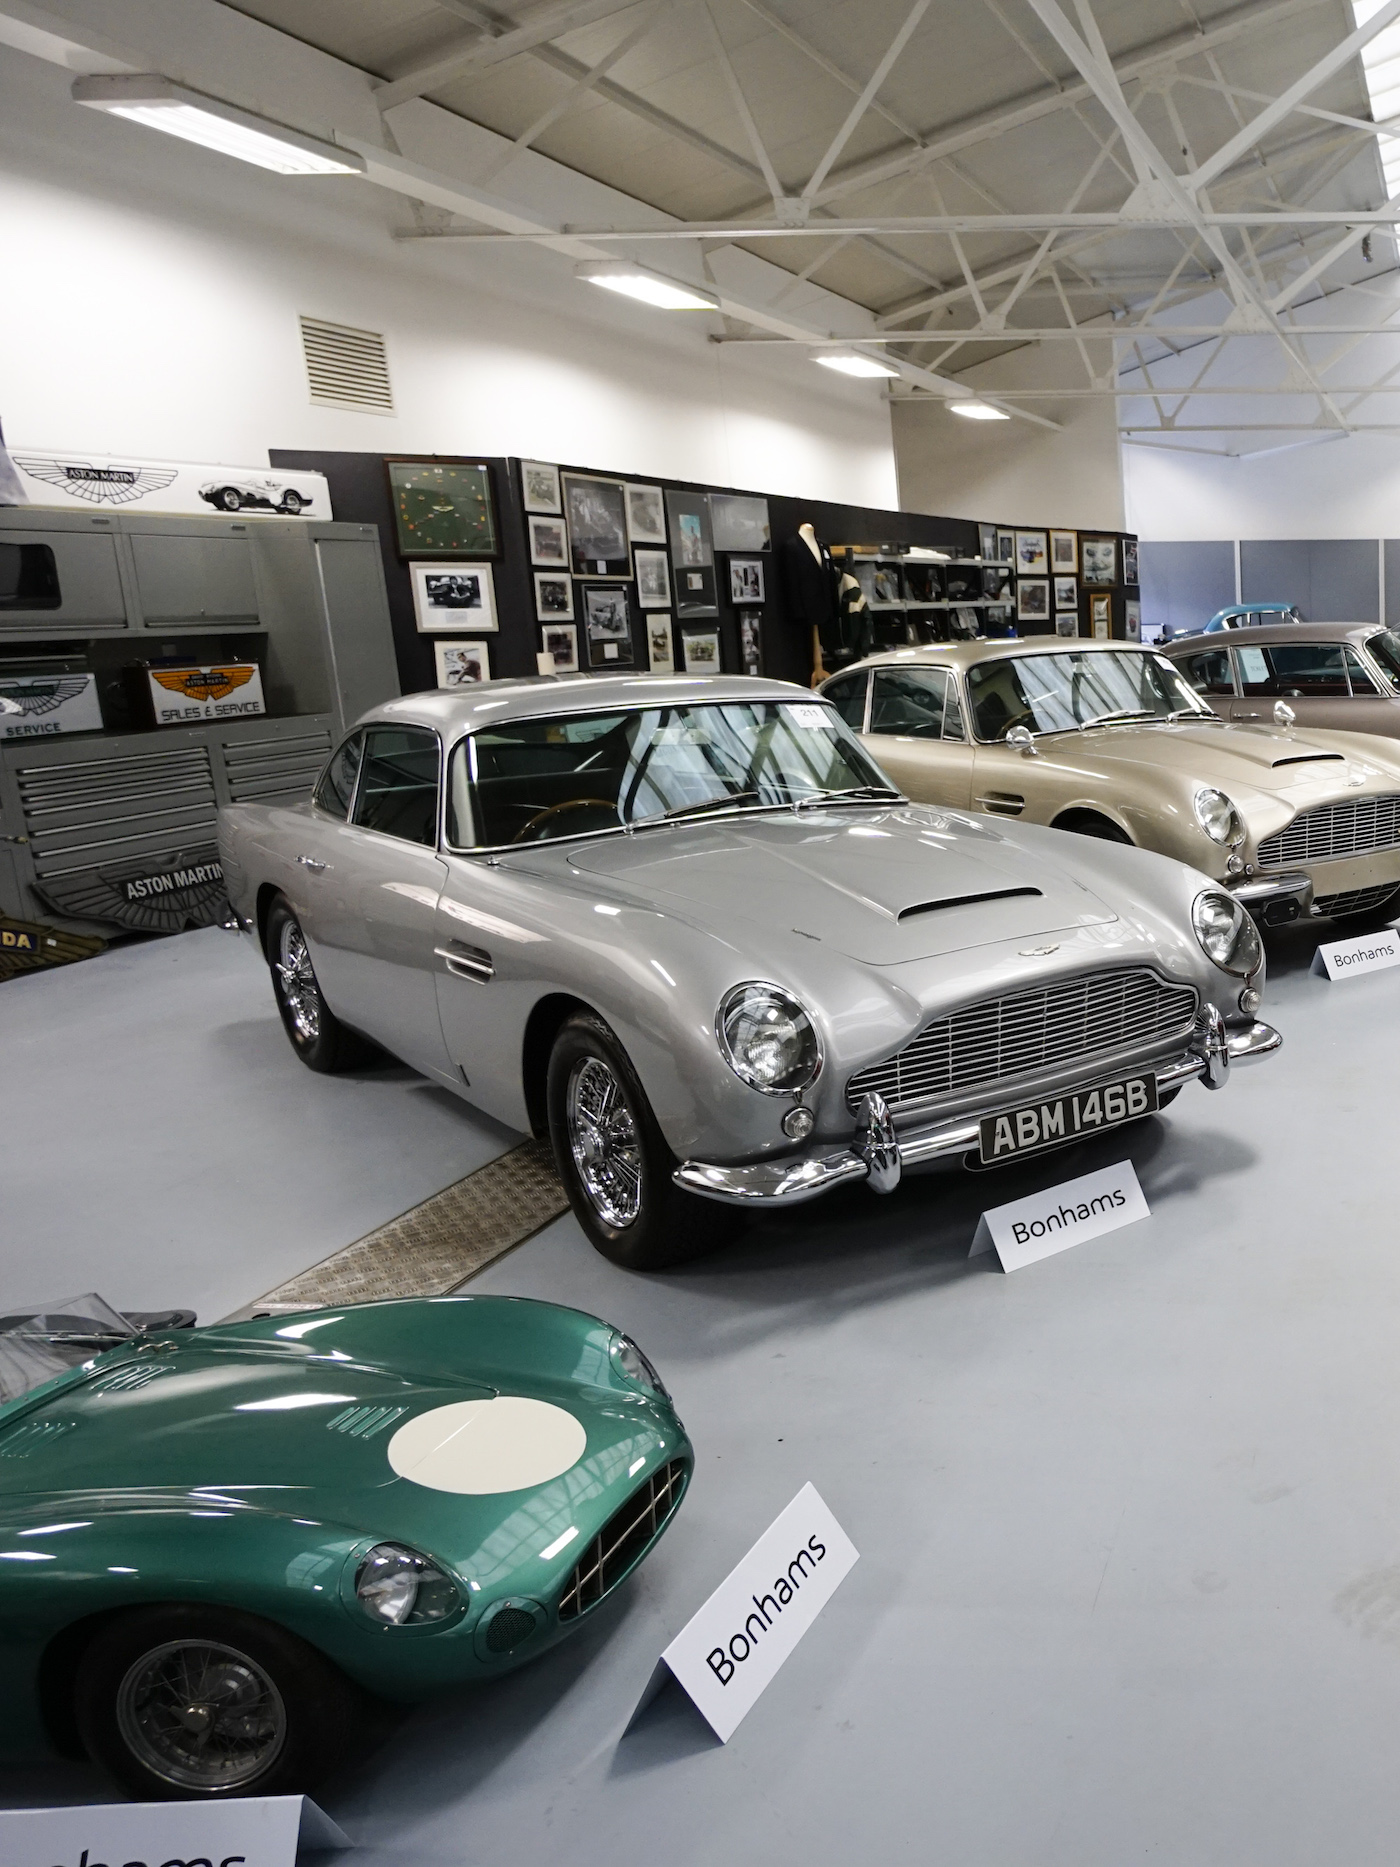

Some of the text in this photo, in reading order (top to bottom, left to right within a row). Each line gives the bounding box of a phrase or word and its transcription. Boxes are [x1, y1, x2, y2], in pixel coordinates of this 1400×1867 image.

[68, 469, 134, 482] ASTON MARTIN
[161, 702, 260, 721] SALES & SERVICE
[800, 709, 819, 717] 211
[6, 723, 61, 736] SERVICE
[127, 874, 174, 900] ASTON
[1333, 944, 1395, 968] Bonhams
[993, 1079, 1149, 1155] ABM 146B
[1011, 1189, 1126, 1245] Bonhams
[705, 1534, 827, 1687] Bonhams
